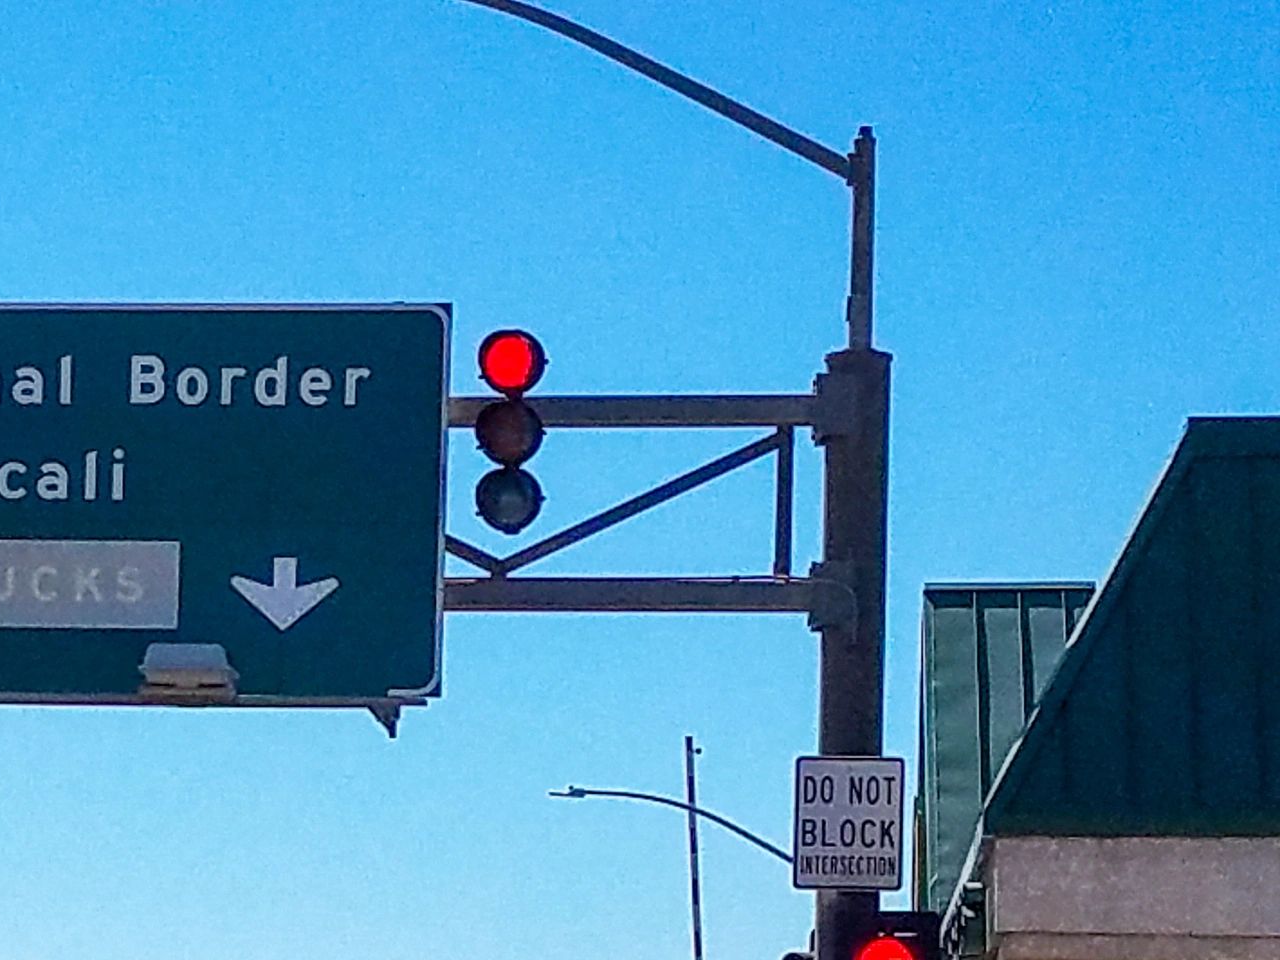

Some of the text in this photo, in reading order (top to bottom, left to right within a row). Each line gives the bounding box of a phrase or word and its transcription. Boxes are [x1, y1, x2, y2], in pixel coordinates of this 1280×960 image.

[129, 354, 371, 406] Border
[802, 775, 897, 806] DO NOT
[800, 818, 896, 849] BLOCK
[800, 854, 897, 876] INTERSECTION
